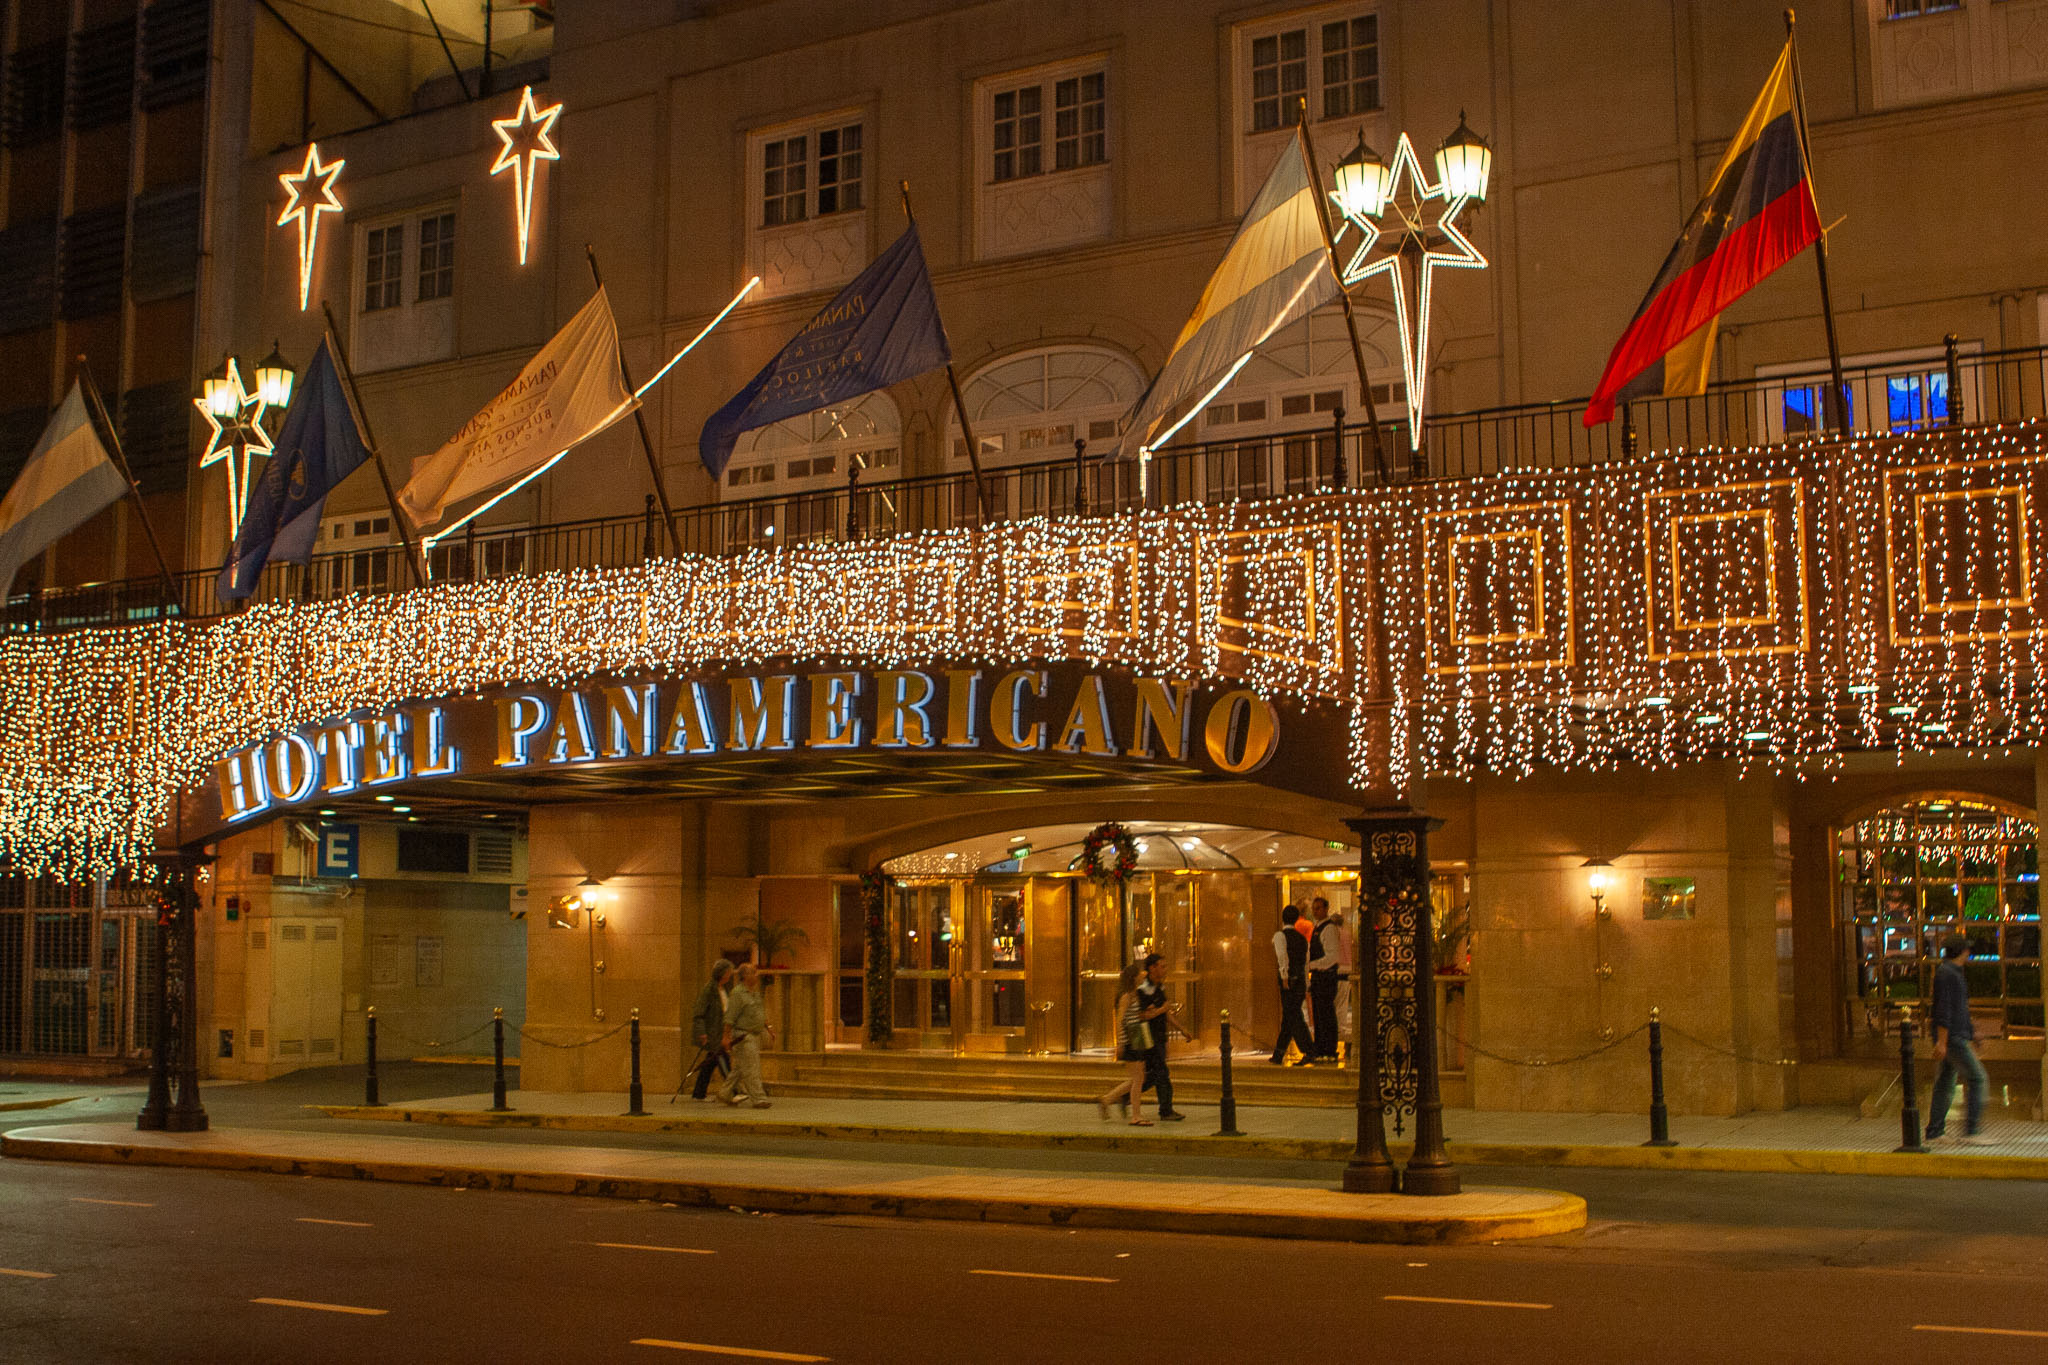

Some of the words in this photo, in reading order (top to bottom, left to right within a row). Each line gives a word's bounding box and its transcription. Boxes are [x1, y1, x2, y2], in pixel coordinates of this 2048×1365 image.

[216, 707, 461, 822] HOTEL
[494, 669, 1280, 775] PANAMERICANO
[326, 832, 350, 868] E
